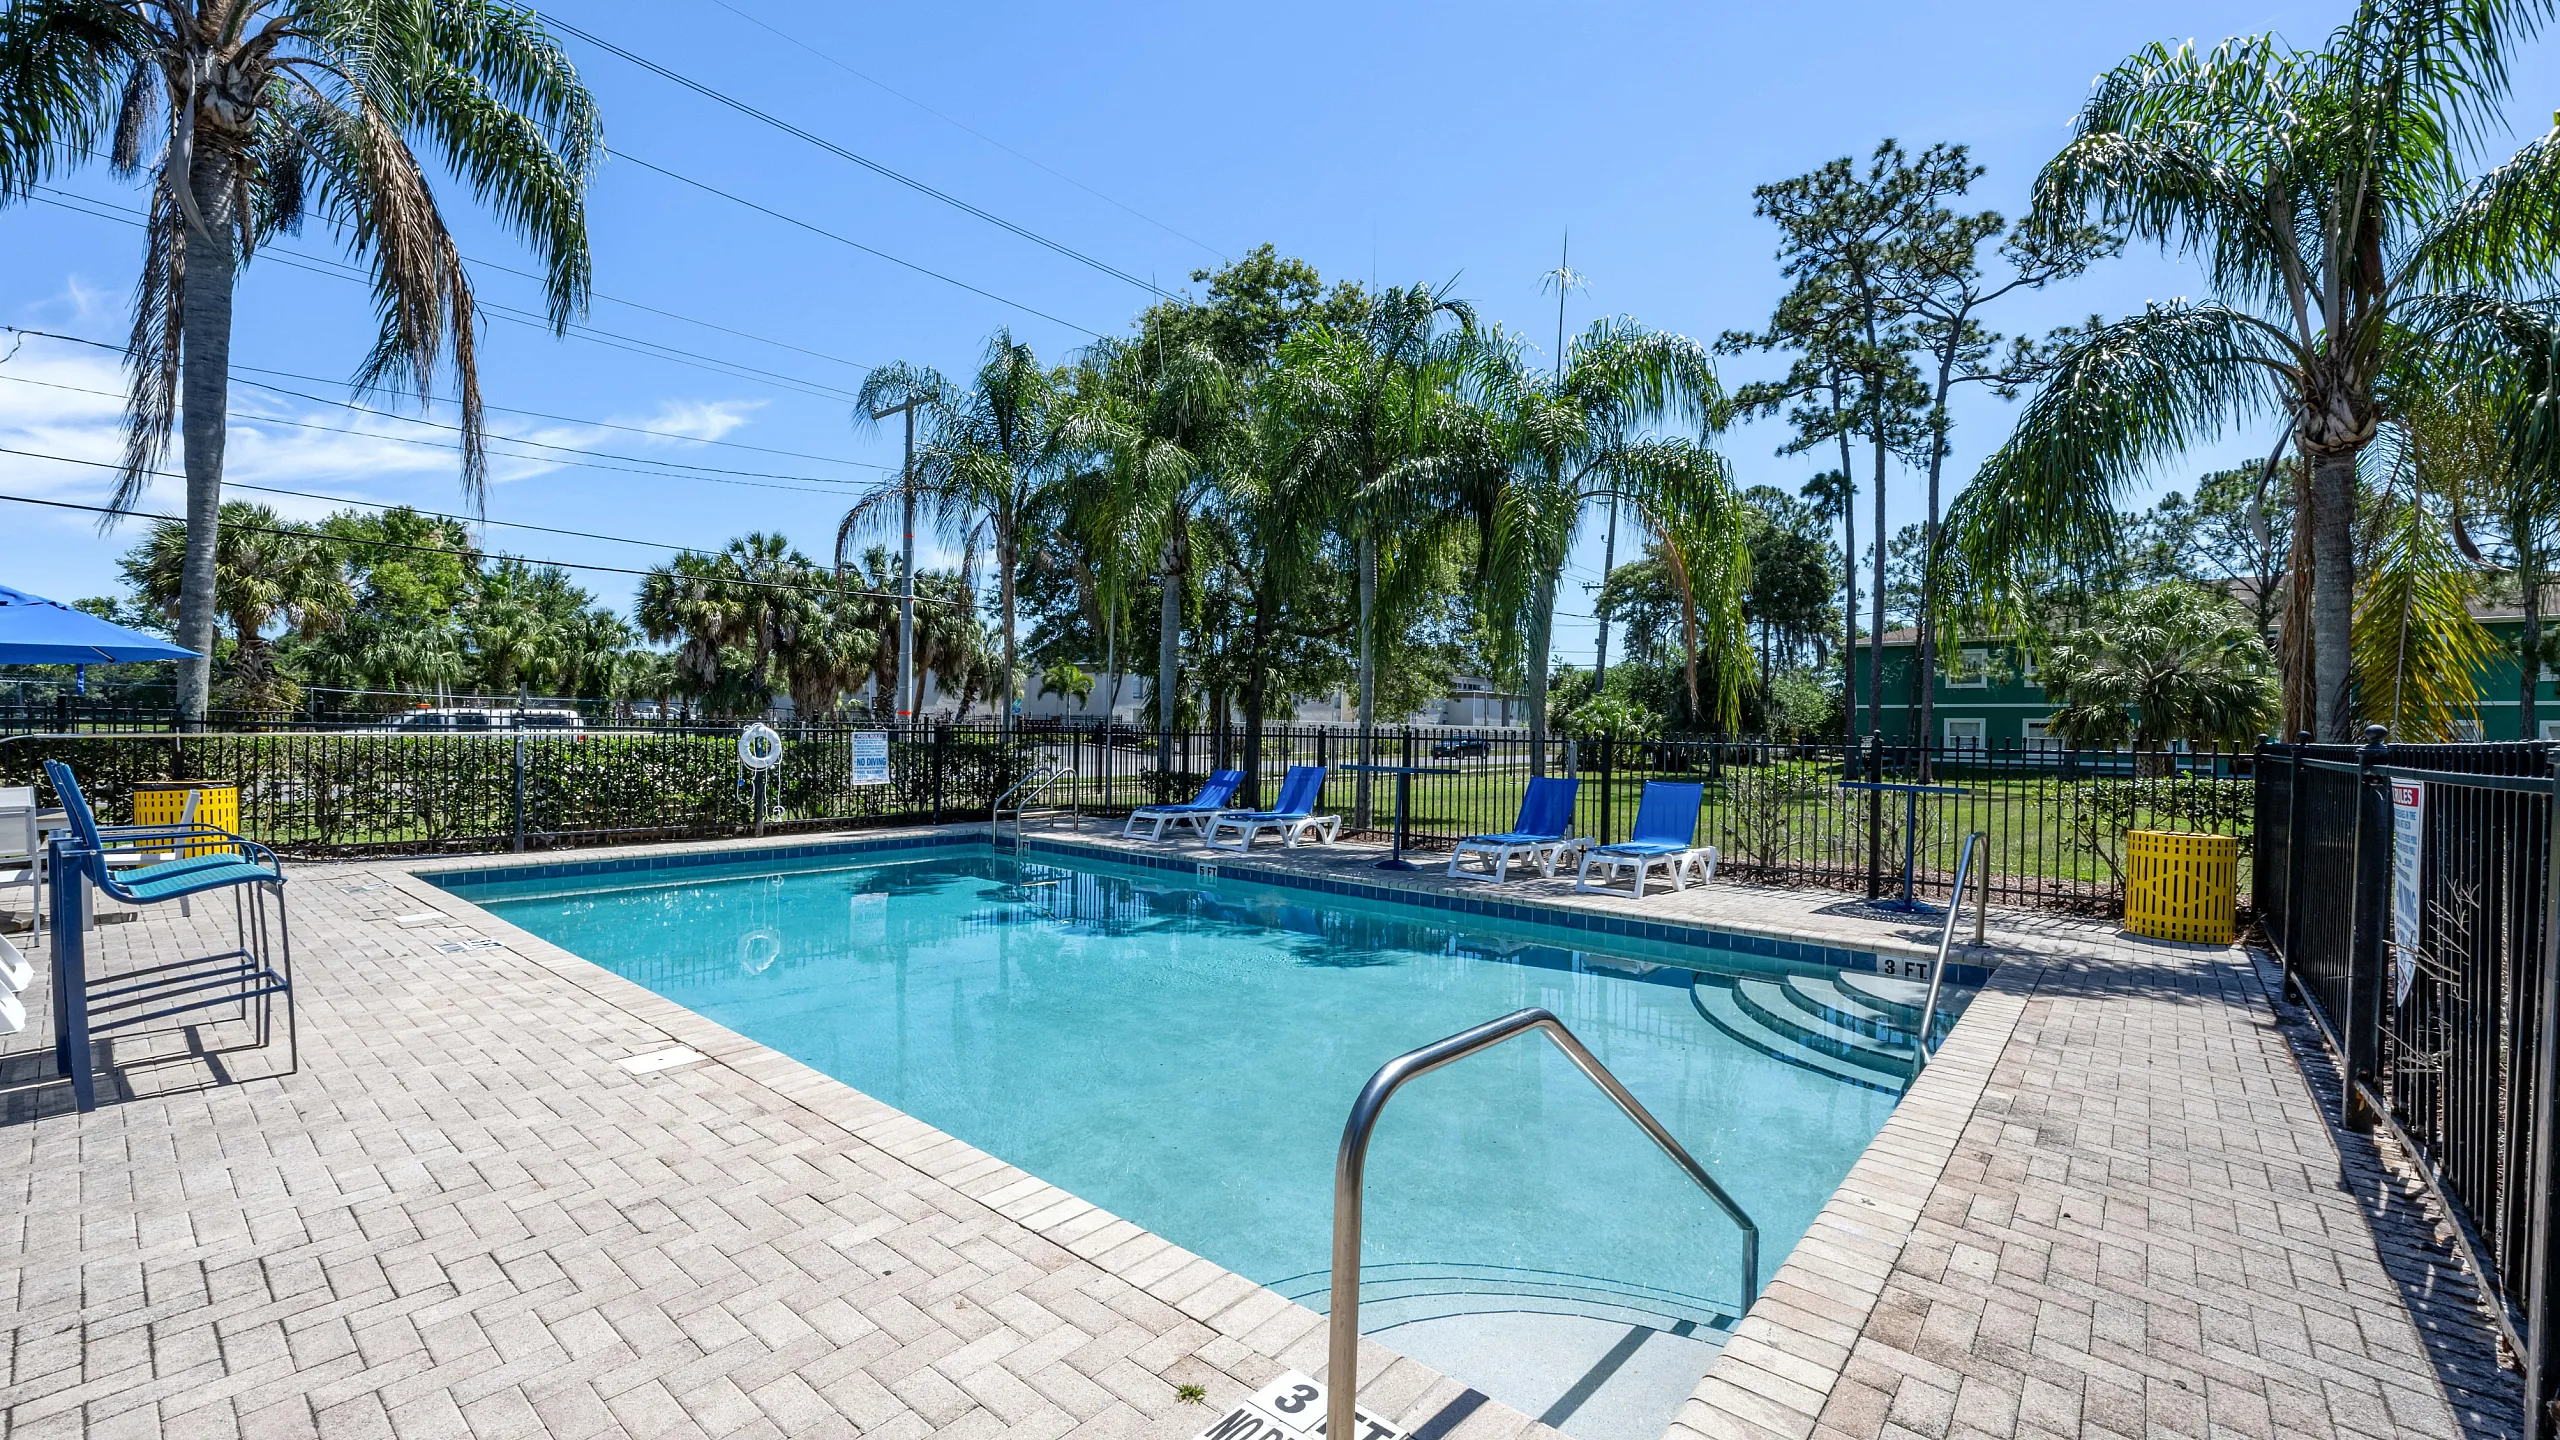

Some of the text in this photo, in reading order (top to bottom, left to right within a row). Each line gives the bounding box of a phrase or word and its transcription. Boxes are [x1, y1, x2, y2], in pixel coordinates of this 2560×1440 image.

[857, 758, 886, 766] NO DIVING
[1199, 865, 1217, 878] 5 FT
[1884, 959, 1896, 975] 3
[1274, 1384, 1320, 1414] 3
[1315, 1411, 1397, 1440] T
[1203, 1408, 1264, 1440] NO
